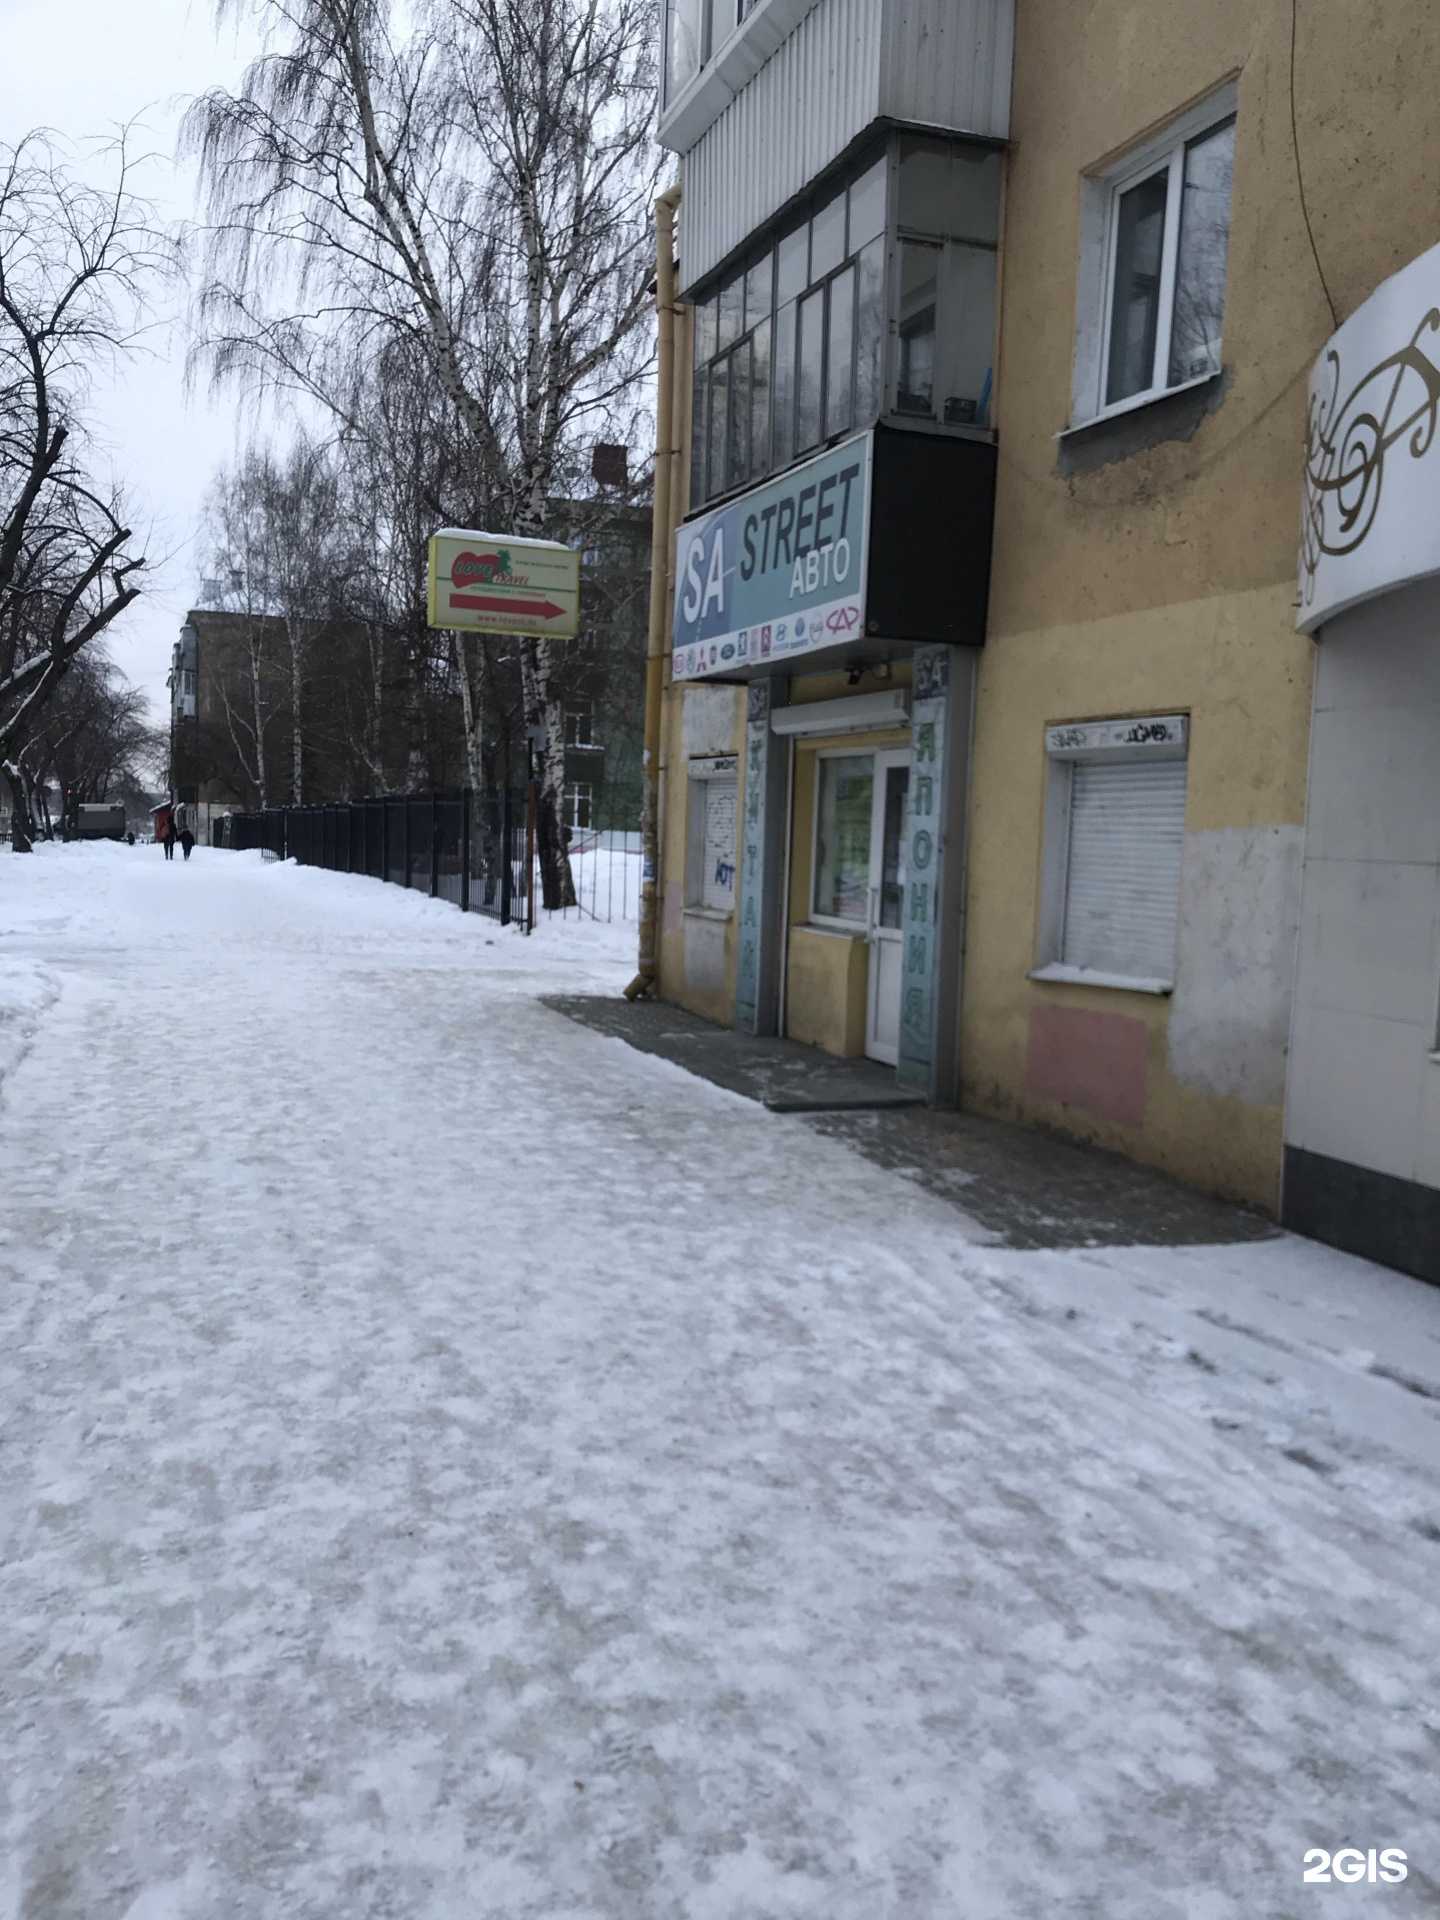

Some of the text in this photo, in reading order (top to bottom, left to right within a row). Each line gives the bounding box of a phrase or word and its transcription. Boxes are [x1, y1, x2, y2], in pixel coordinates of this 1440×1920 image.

[683, 463, 860, 624] SA STREET
[789, 538, 851, 600] АВТО
